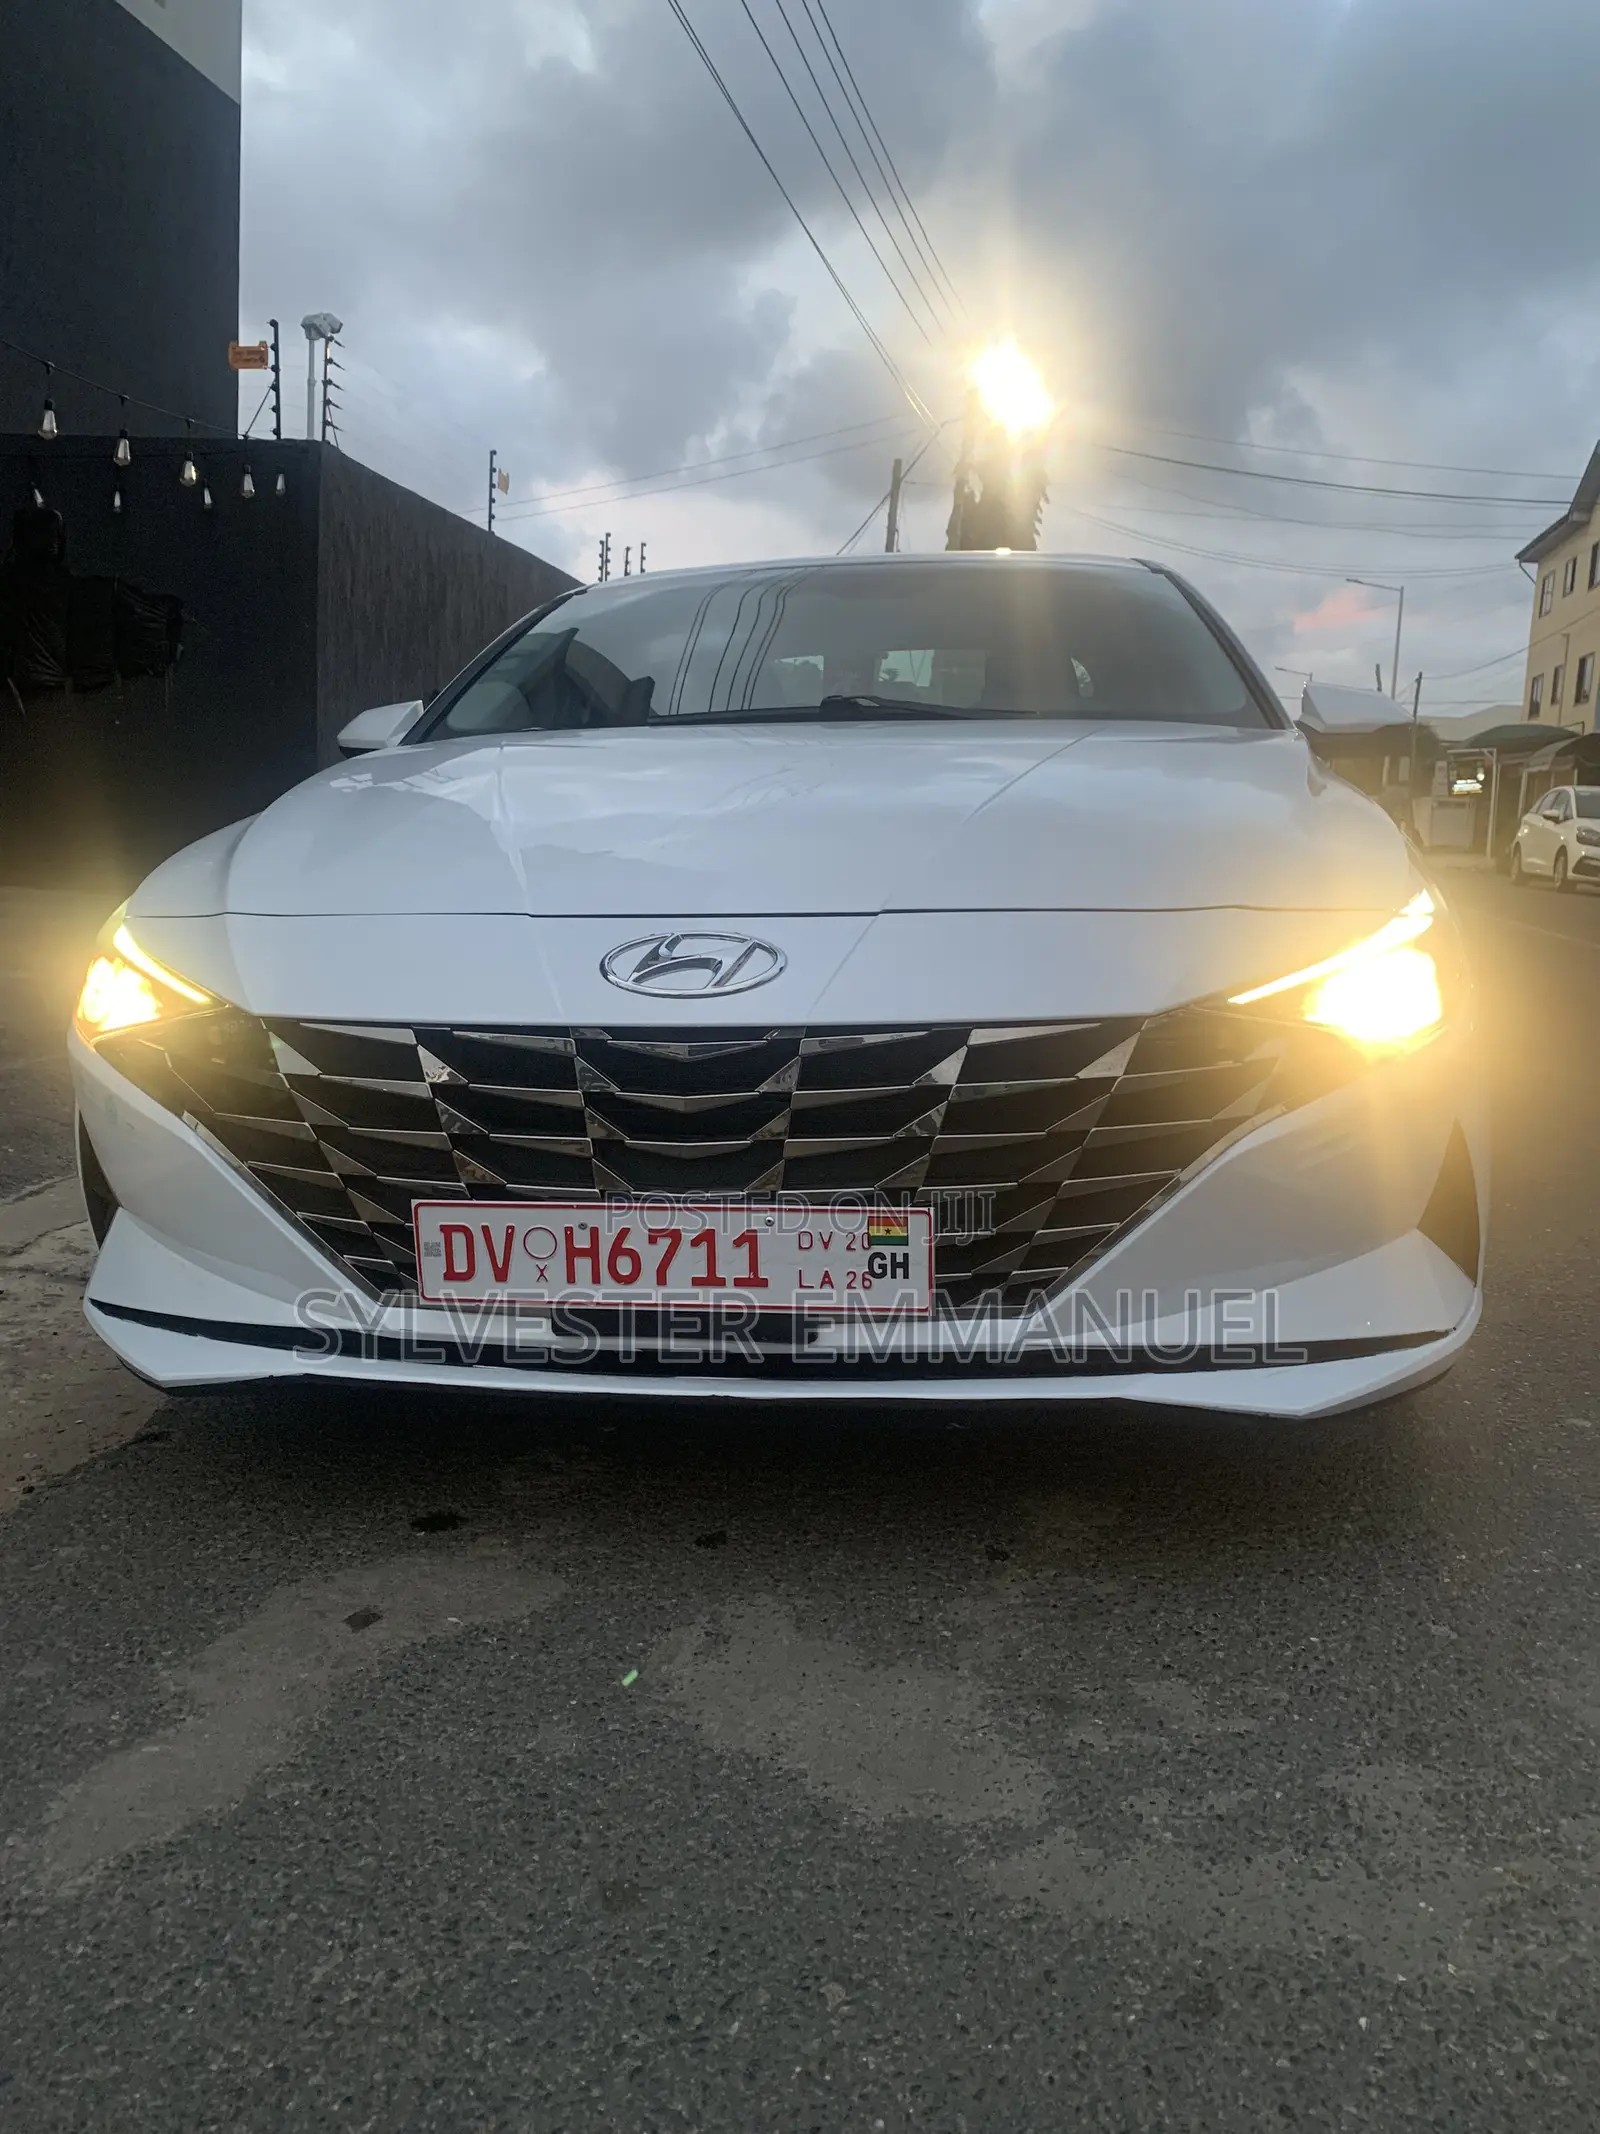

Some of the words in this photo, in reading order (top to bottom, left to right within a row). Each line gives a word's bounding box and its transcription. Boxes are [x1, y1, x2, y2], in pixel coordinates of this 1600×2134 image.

[798, 1230, 834, 1251] DV
[845, 1231, 872, 1252] 20
[439, 1224, 516, 1283] DV
[564, 1225, 769, 1288] H6711
[867, 1251, 910, 1280] GH
[798, 1268, 835, 1290] LA
[845, 1270, 873, 1290] 26
